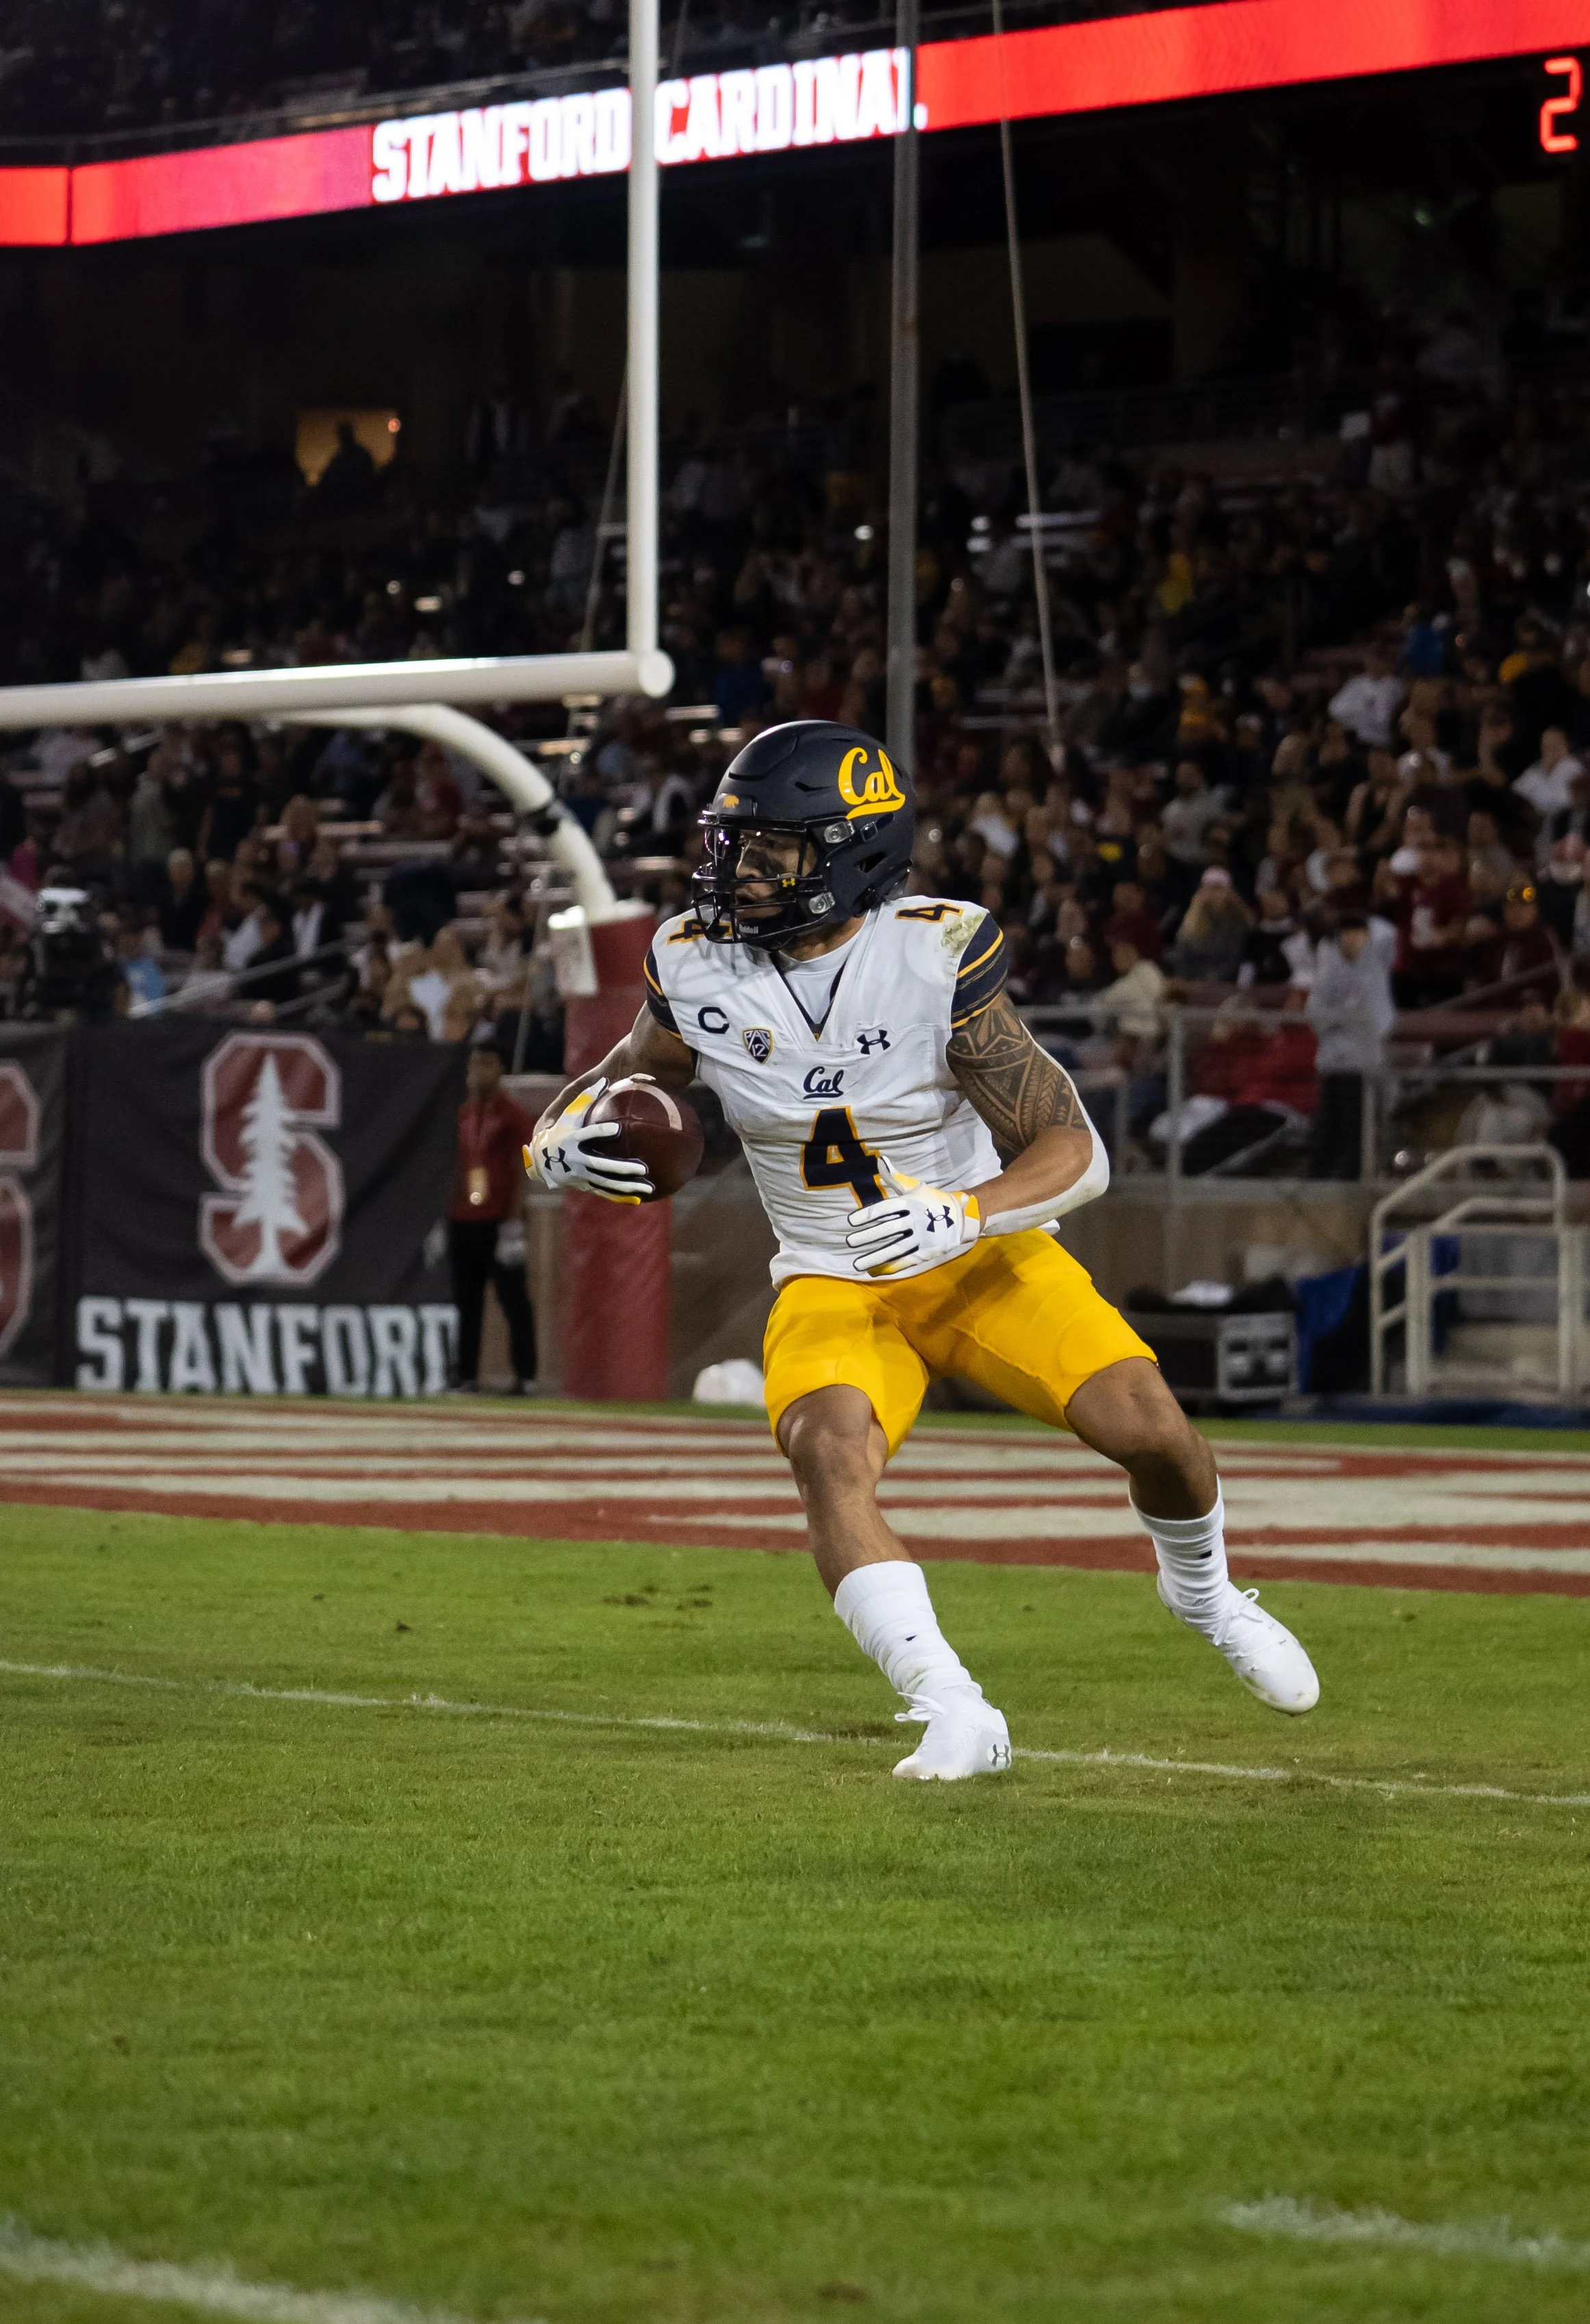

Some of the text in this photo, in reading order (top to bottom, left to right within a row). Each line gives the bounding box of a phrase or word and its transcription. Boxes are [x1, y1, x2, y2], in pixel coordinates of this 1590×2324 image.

[1539, 56, 1582, 153] 2
[372, 86, 632, 203] STANFORD
[838, 747, 906, 820] Cal
[895, 902, 964, 923] 4
[697, 1006, 730, 1035] C
[743, 1030, 771, 1050] PAC
[752, 1043, 767, 1057] 12
[803, 1066, 845, 1100] Cal
[799, 1105, 890, 1210] 4
